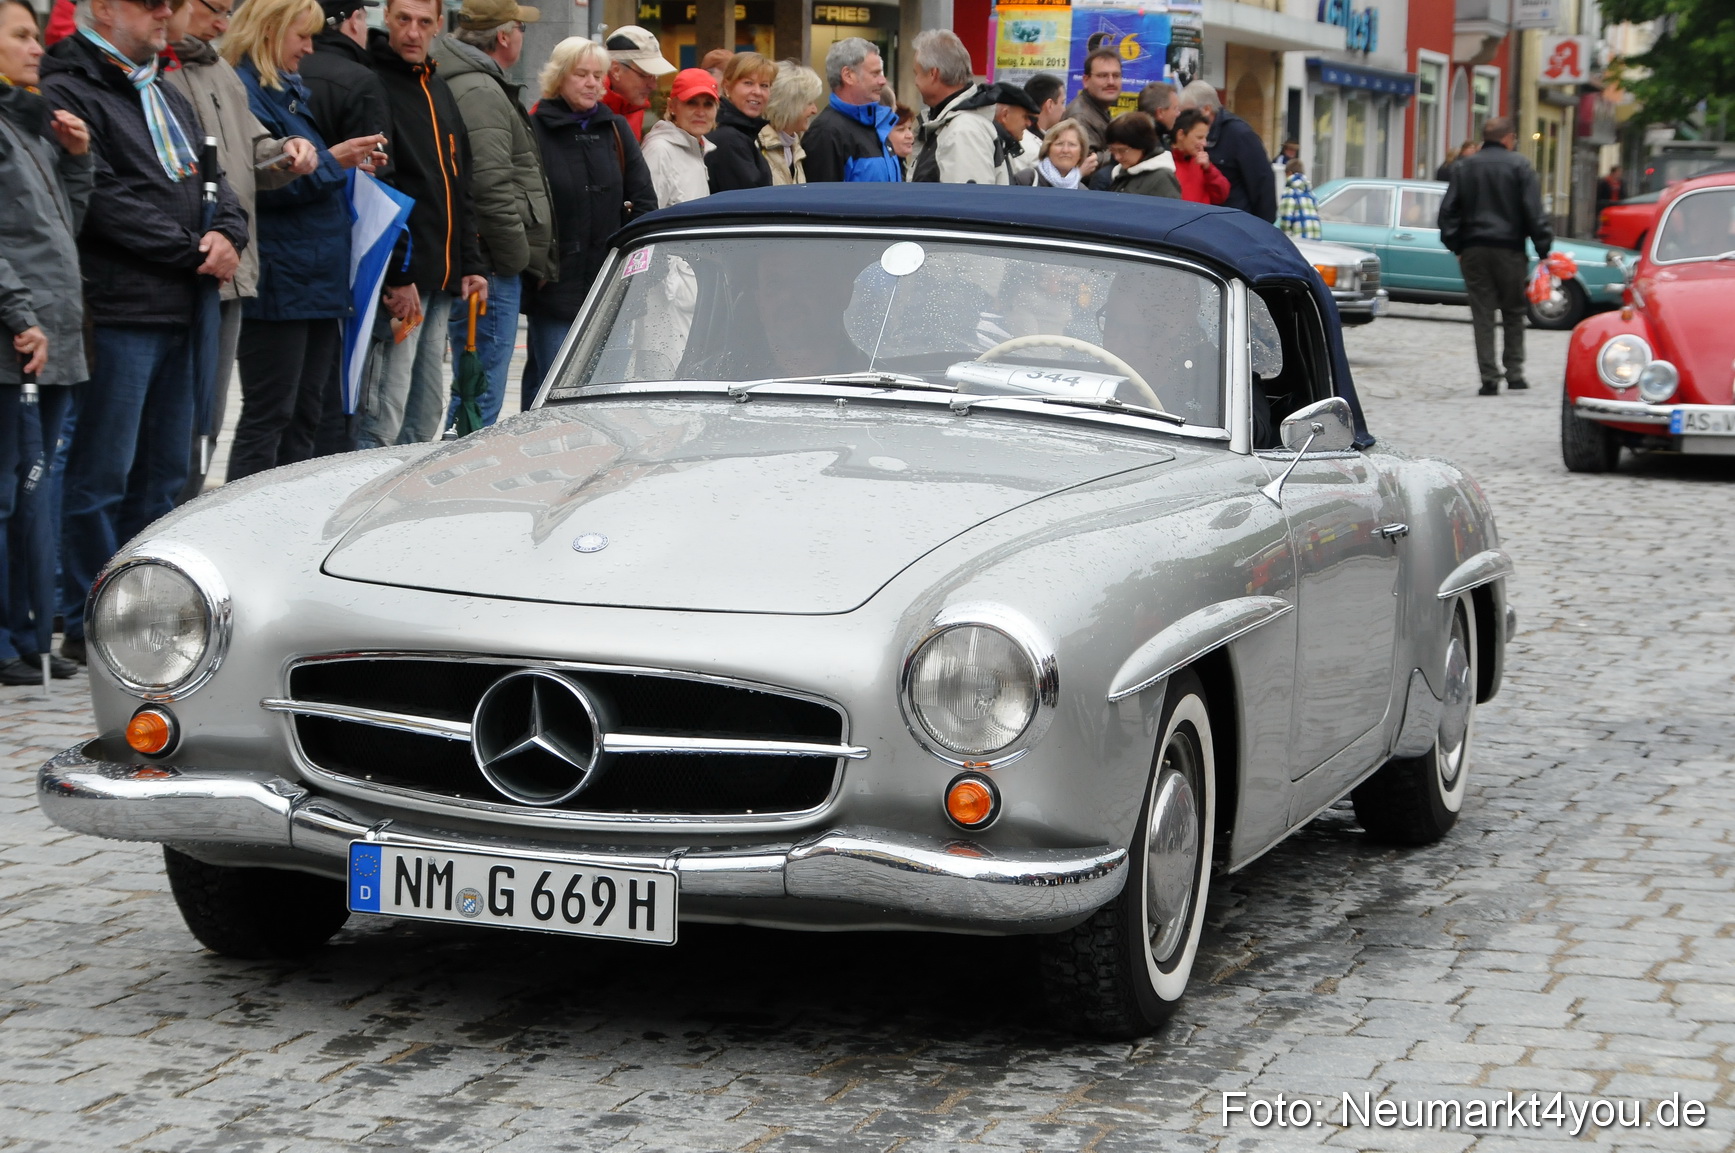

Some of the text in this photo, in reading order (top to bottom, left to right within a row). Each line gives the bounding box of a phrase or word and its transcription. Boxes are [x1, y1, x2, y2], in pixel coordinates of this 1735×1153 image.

[814, 5, 870, 22] FRIES
[1029, 57, 1044, 66] Juni
[1046, 57, 1067, 67] 2013
[1026, 370, 1082, 387] 344
[1685, 412, 1711, 431] AS
[360, 885, 371, 901] D
[394, 855, 454, 911] NM
[488, 864, 515, 917] G
[530, 870, 656, 932] 669H
